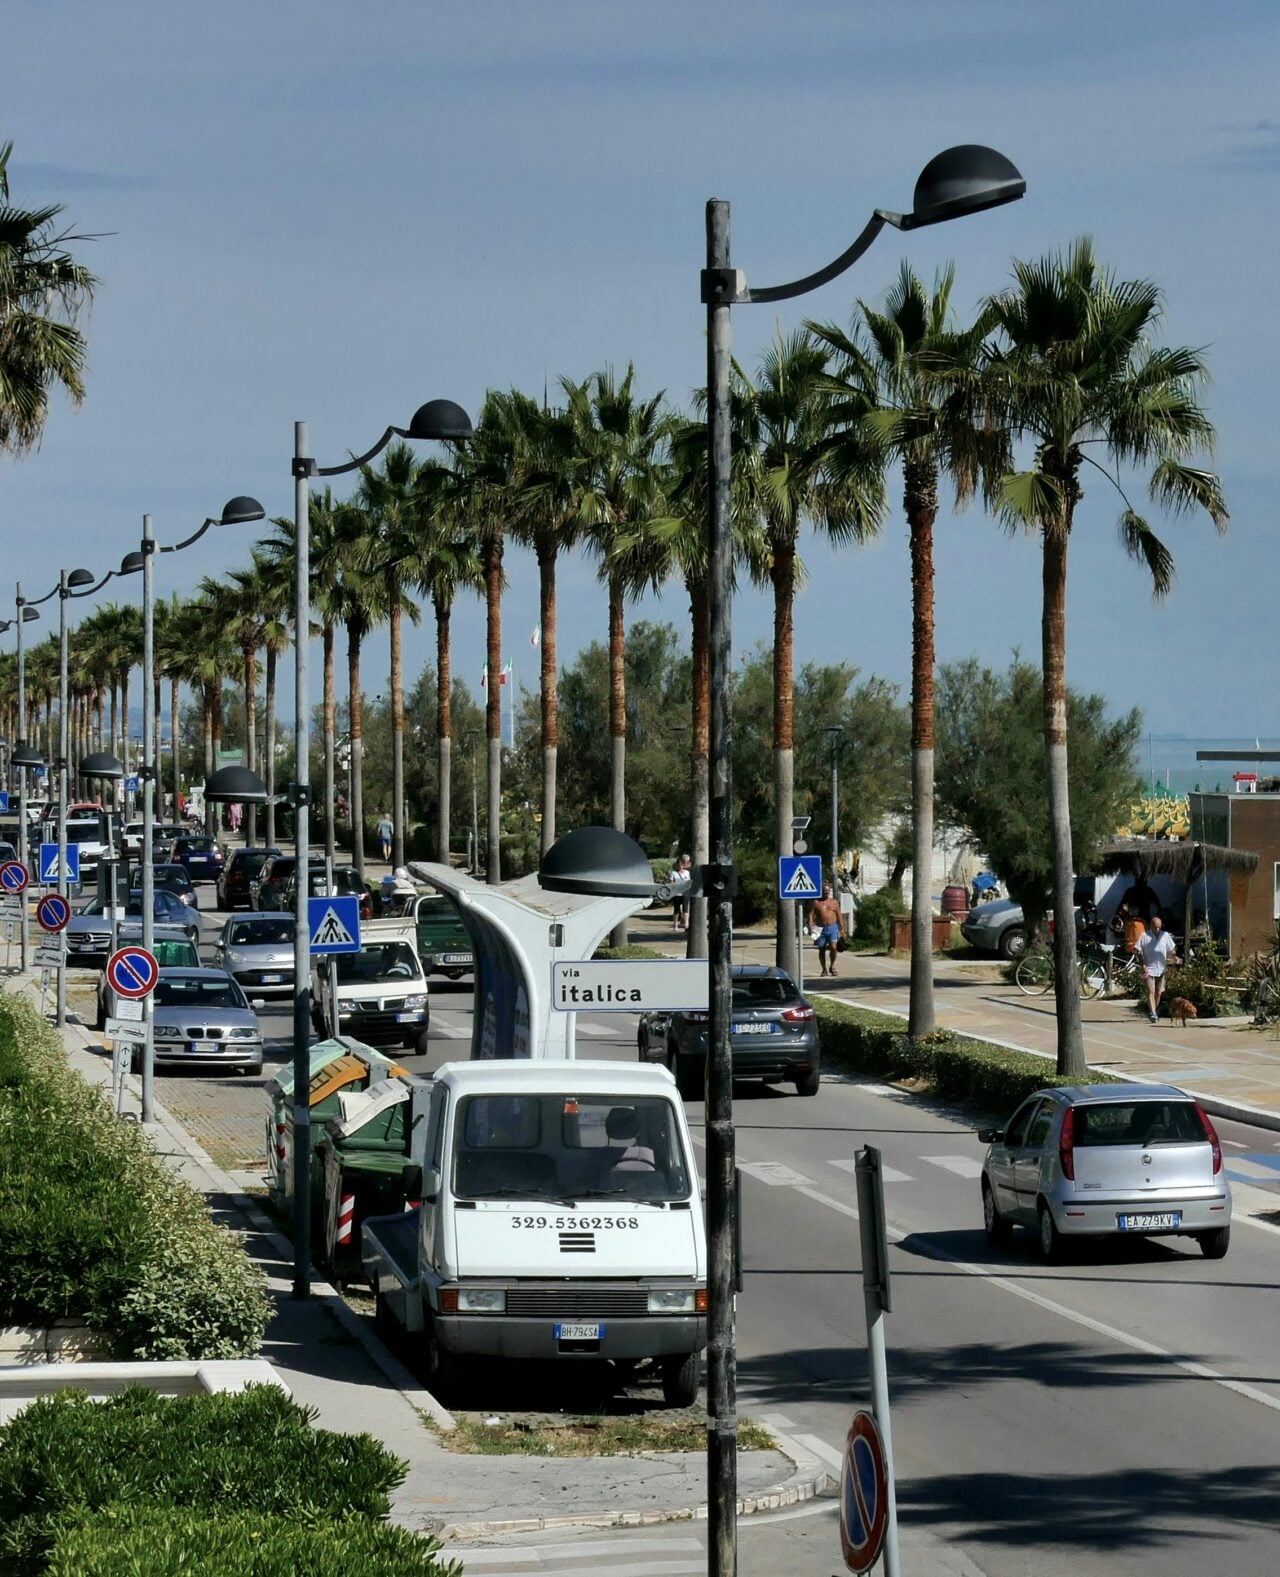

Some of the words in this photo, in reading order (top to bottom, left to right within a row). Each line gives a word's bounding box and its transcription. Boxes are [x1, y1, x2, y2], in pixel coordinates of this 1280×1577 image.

[562, 968, 580, 977] via
[561, 984, 642, 1002] italica
[511, 1216, 639, 1229] 329.5362368
